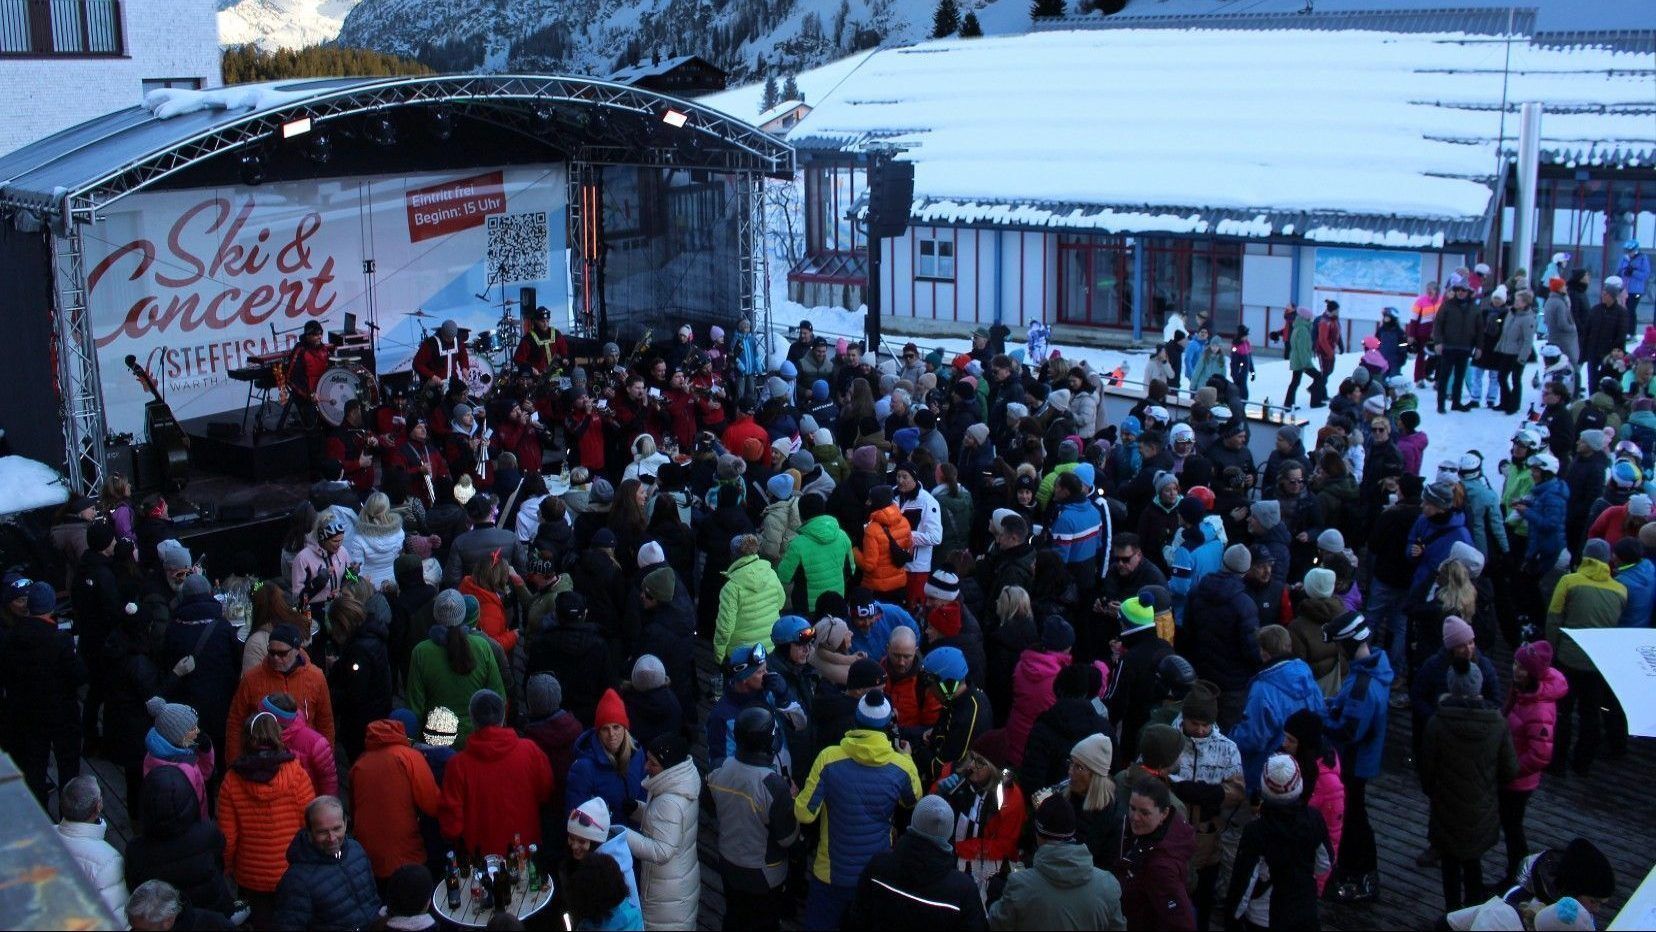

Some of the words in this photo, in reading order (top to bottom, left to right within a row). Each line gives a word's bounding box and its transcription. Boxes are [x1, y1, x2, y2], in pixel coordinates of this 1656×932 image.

[412, 188, 452, 207] Eintritt
[453, 184, 475, 198] frei
[414, 207, 463, 226] Beginn:
[463, 202, 477, 215] 15
[477, 197, 502, 212] Uhr
[154, 195, 269, 288] Ski
[275, 211, 323, 274] &
[72, 239, 338, 348] Concert
[169, 377, 219, 392] WARTH
